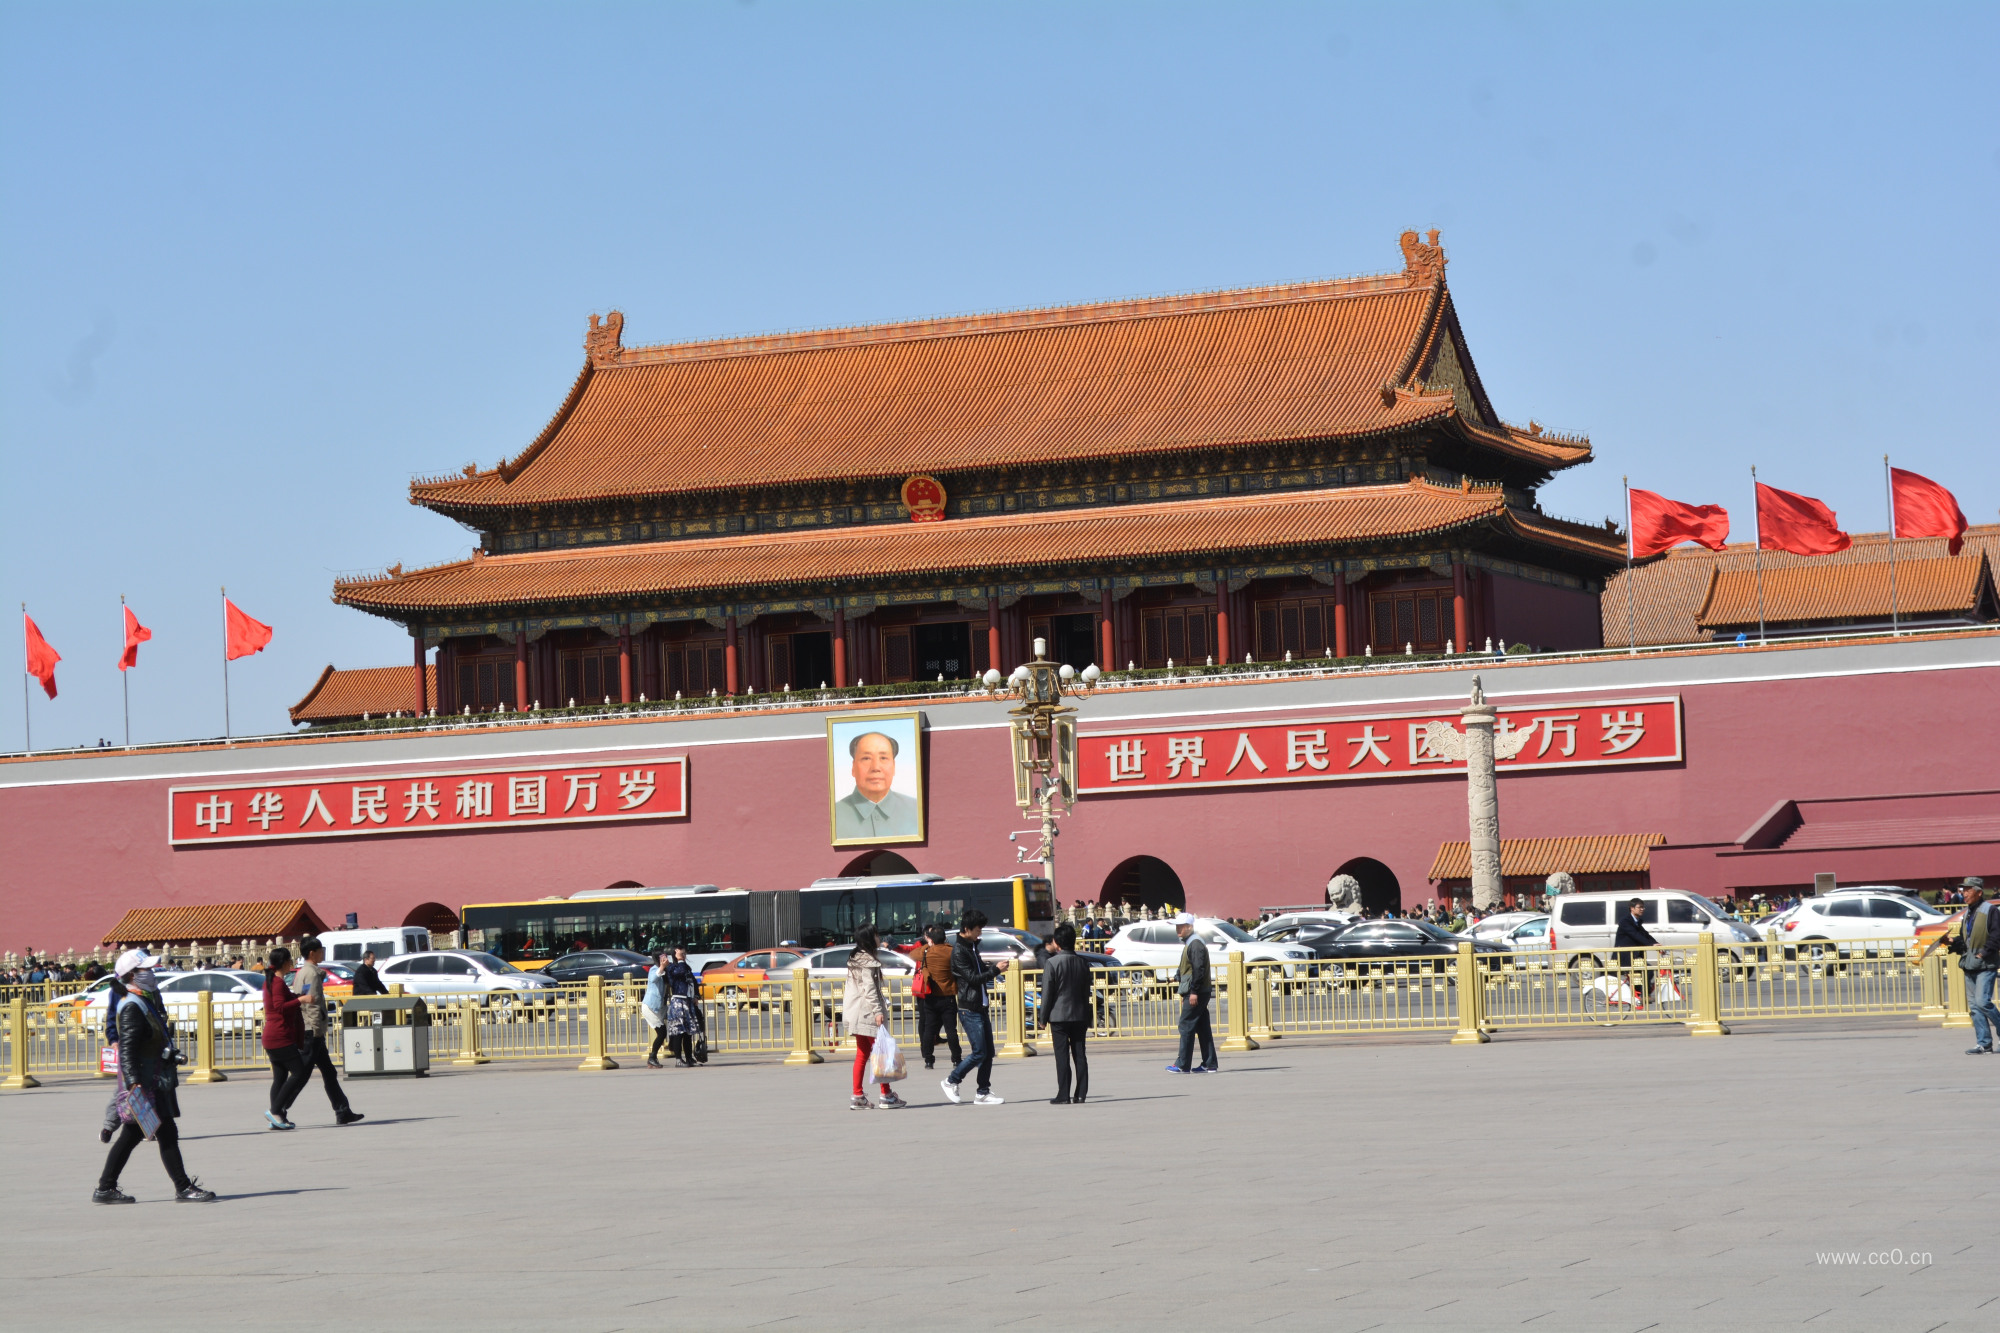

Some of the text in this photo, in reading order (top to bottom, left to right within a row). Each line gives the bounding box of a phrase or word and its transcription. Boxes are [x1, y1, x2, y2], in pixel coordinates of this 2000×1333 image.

[195, 769, 656, 834] 中华人民共和国万岁
